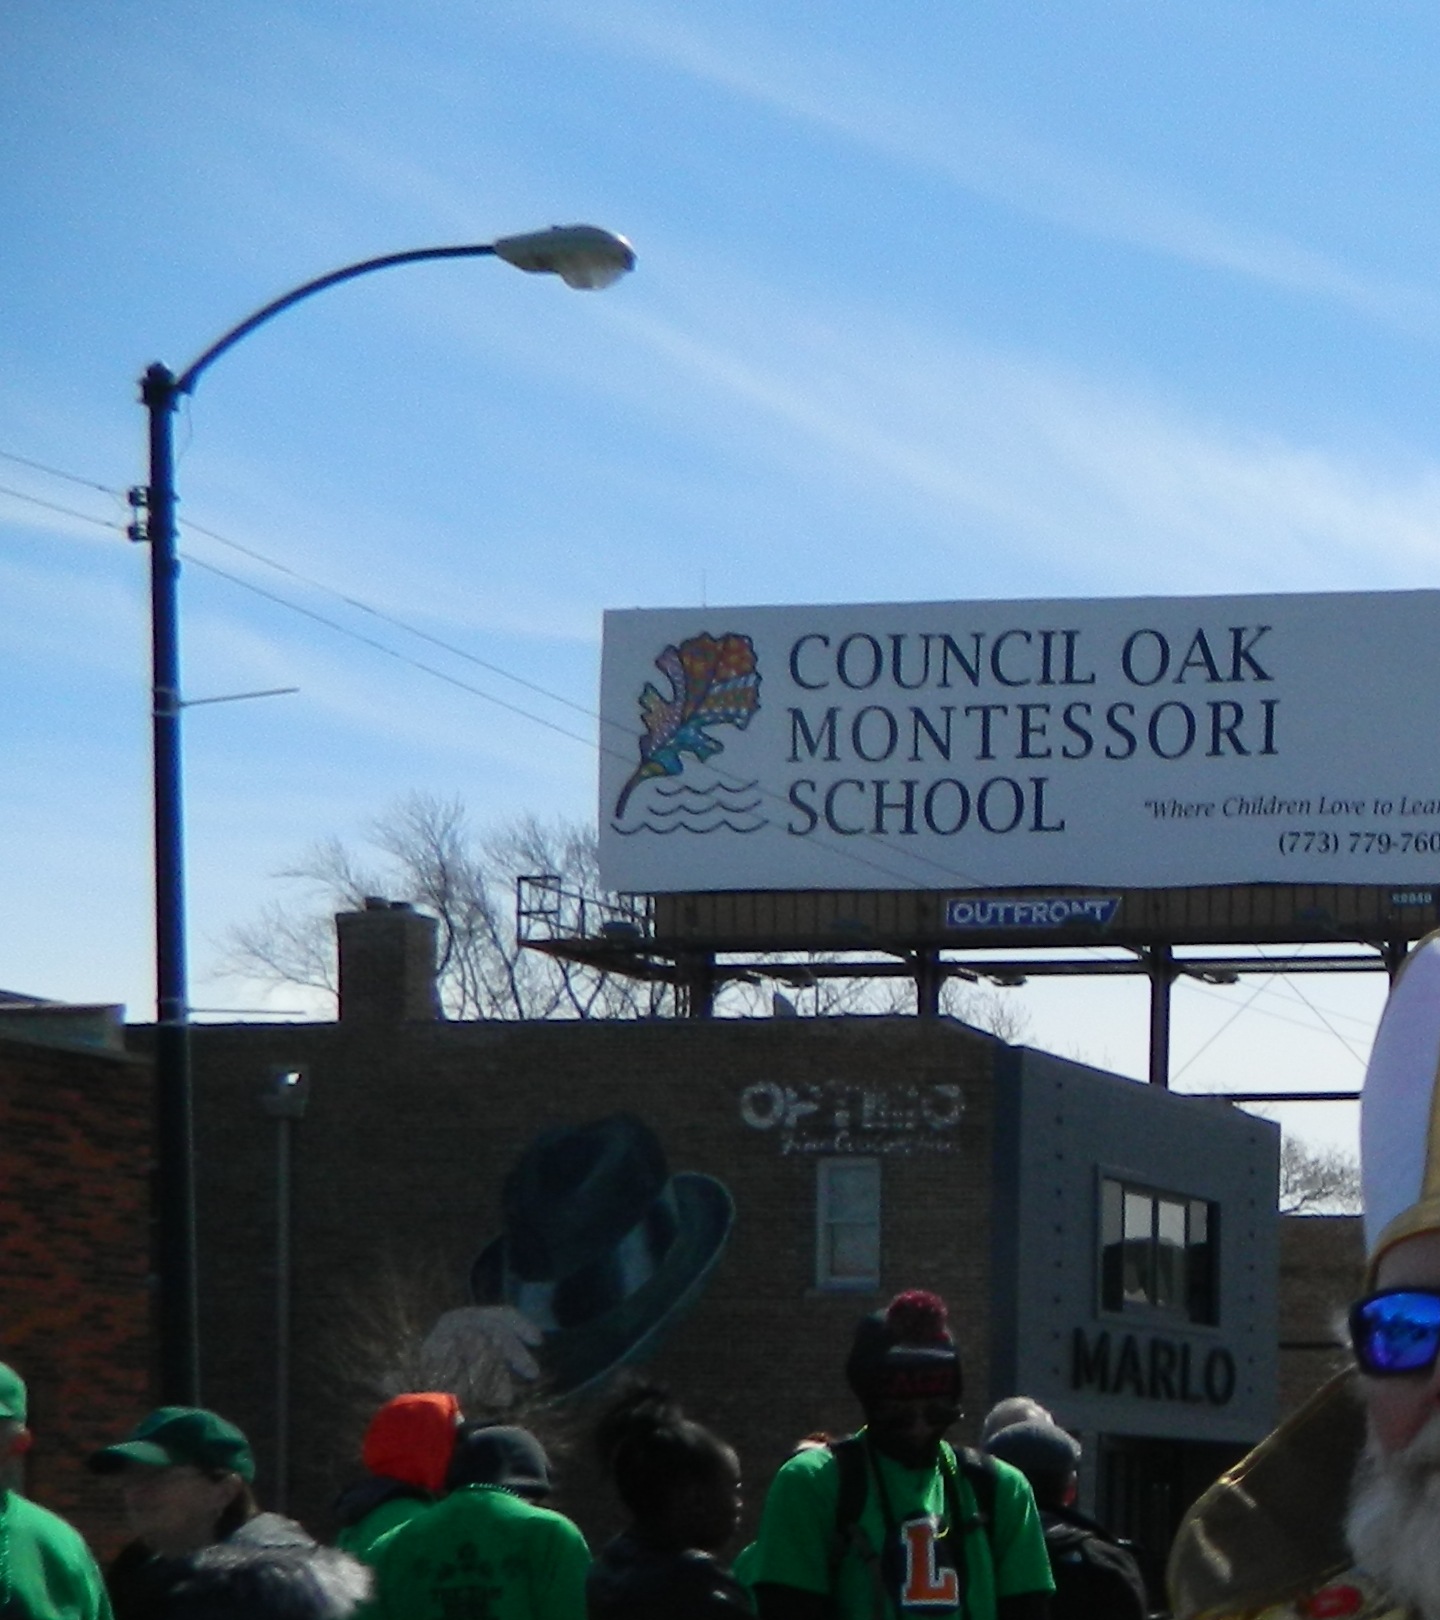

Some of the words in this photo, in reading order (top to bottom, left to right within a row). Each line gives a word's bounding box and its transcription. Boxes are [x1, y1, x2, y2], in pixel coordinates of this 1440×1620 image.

[789, 629, 1097, 690] COUNCIL
[1121, 625, 1274, 687] OAK
[785, 699, 1281, 763] MONTESSORI
[787, 776, 1066, 837] SCHOOL
[1222, 796, 1311, 817] Children
[1318, 796, 1366, 816] Love
[1373, 798, 1394, 816] to
[1278, 831, 1340, 854] (773)
[952, 901, 1111, 924] OUTFRONT
[1071, 1326, 1237, 1406] MARLO
[901, 1518, 960, 1607] L
